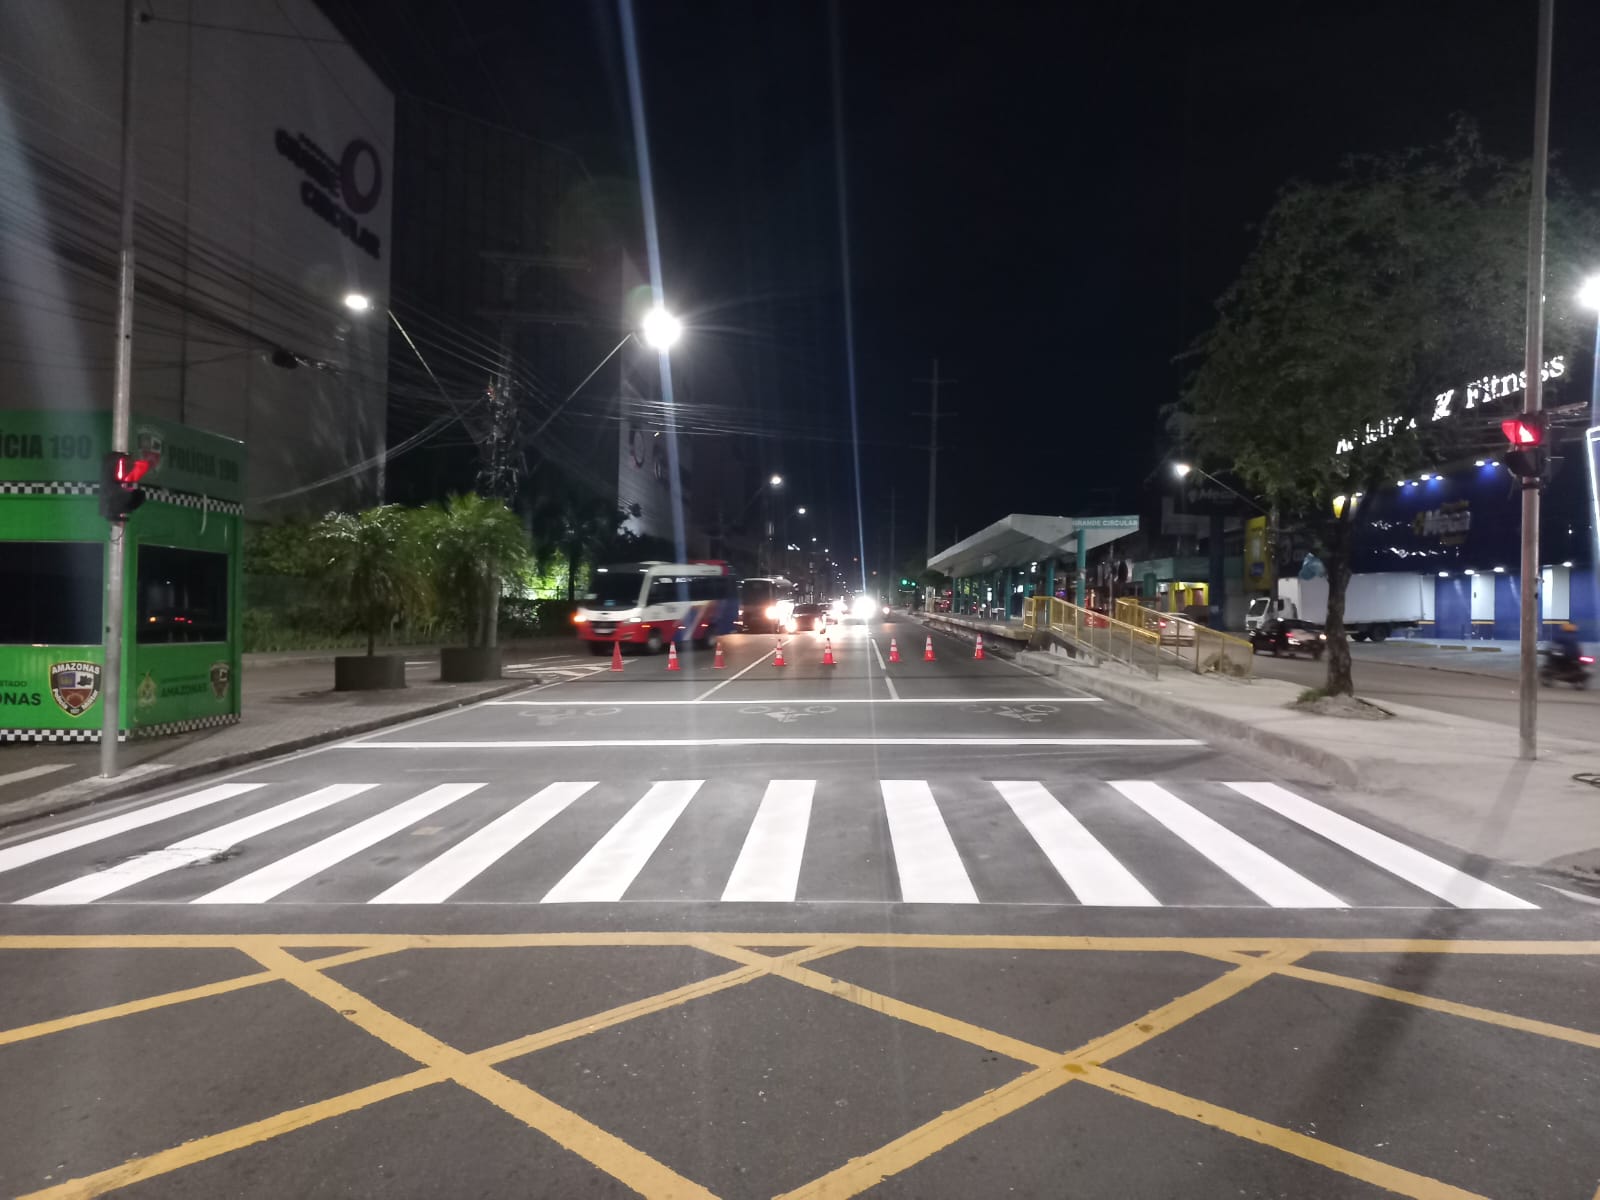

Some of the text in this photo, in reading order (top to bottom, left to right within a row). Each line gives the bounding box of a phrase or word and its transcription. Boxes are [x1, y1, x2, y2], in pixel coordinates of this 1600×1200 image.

[48, 434, 93, 460] 190
[52, 663, 100, 675] AMAZONAS
[0, 692, 42, 706] NAS
